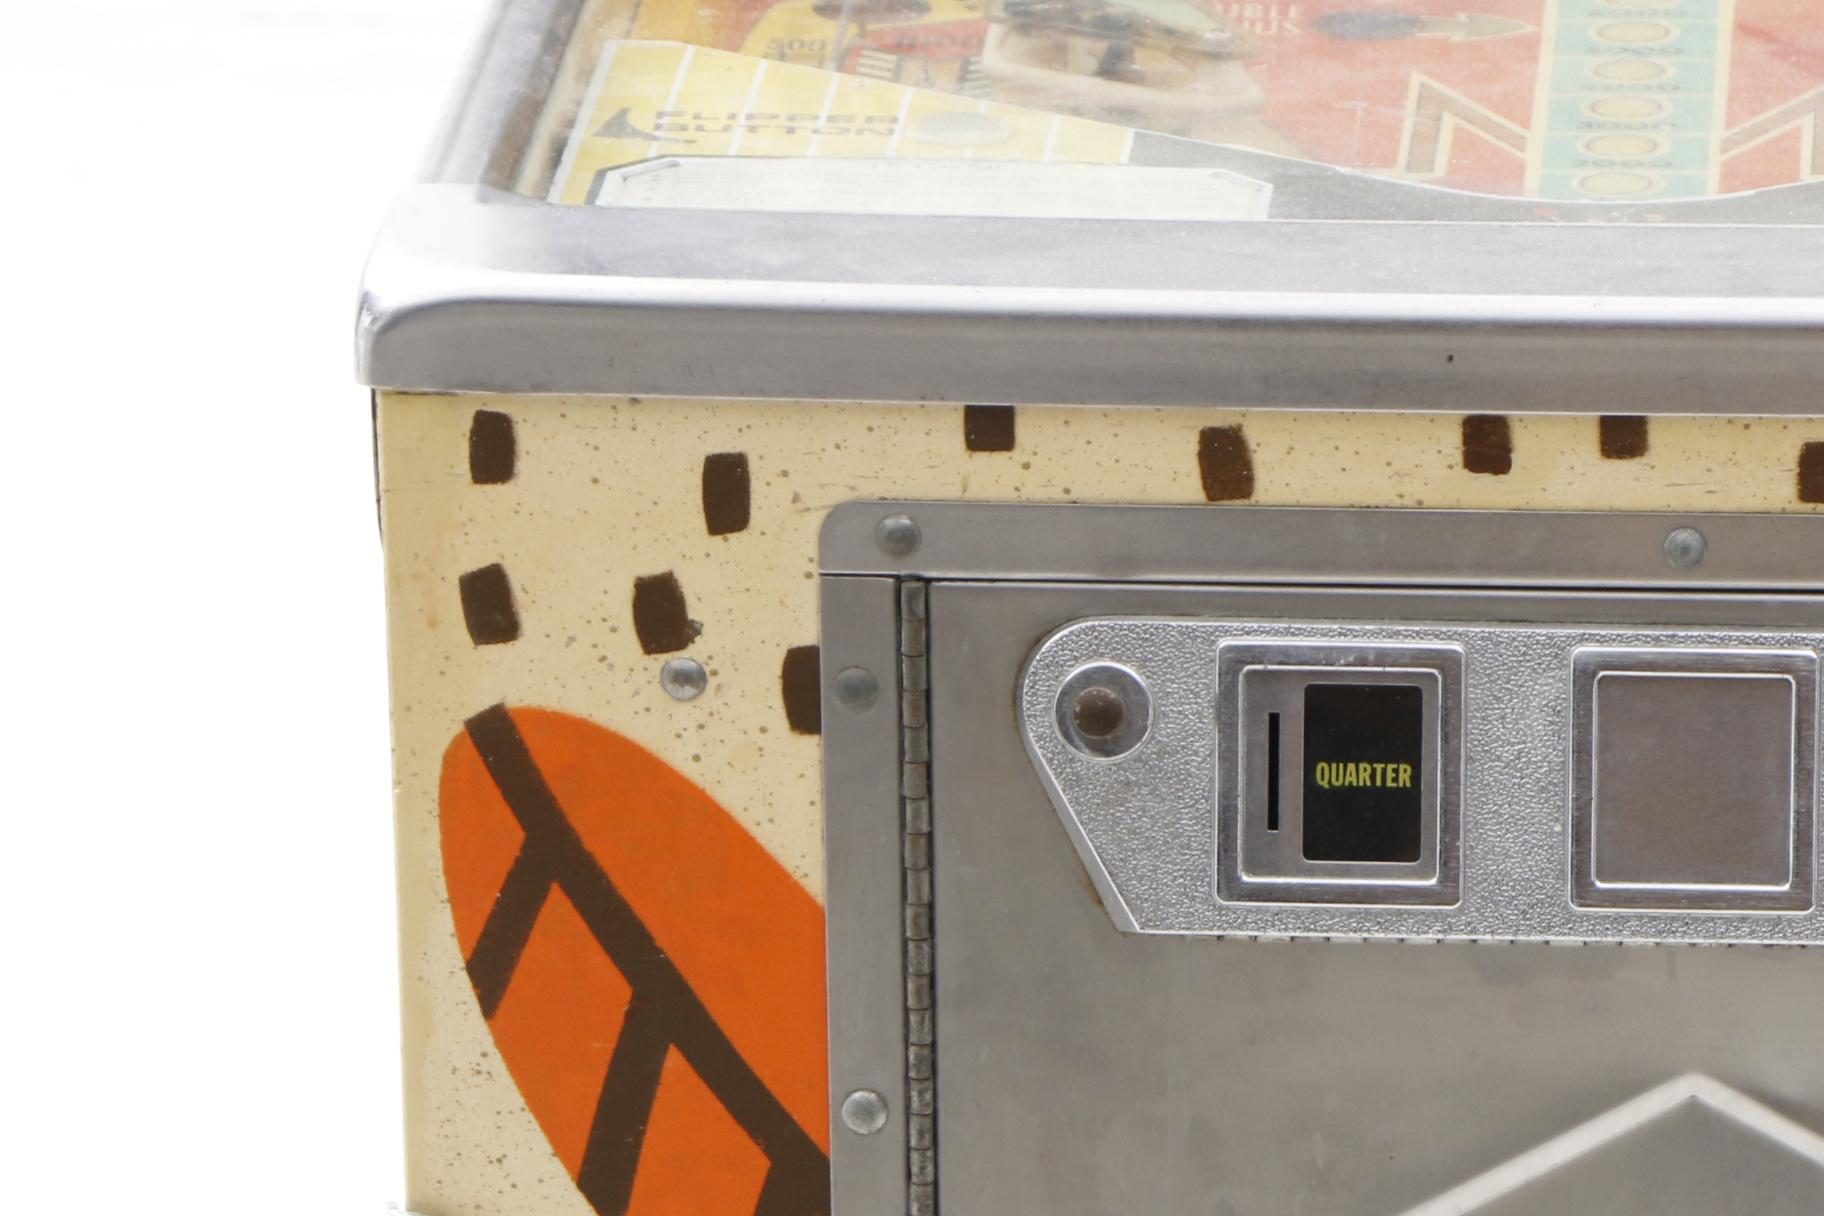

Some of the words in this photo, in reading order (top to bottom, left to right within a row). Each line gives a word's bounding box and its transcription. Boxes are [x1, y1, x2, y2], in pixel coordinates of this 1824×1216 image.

[655, 110, 900, 125] FLIPPER
[653, 123, 897, 137] BUTTON
[1315, 761, 1412, 789] QUARTER
